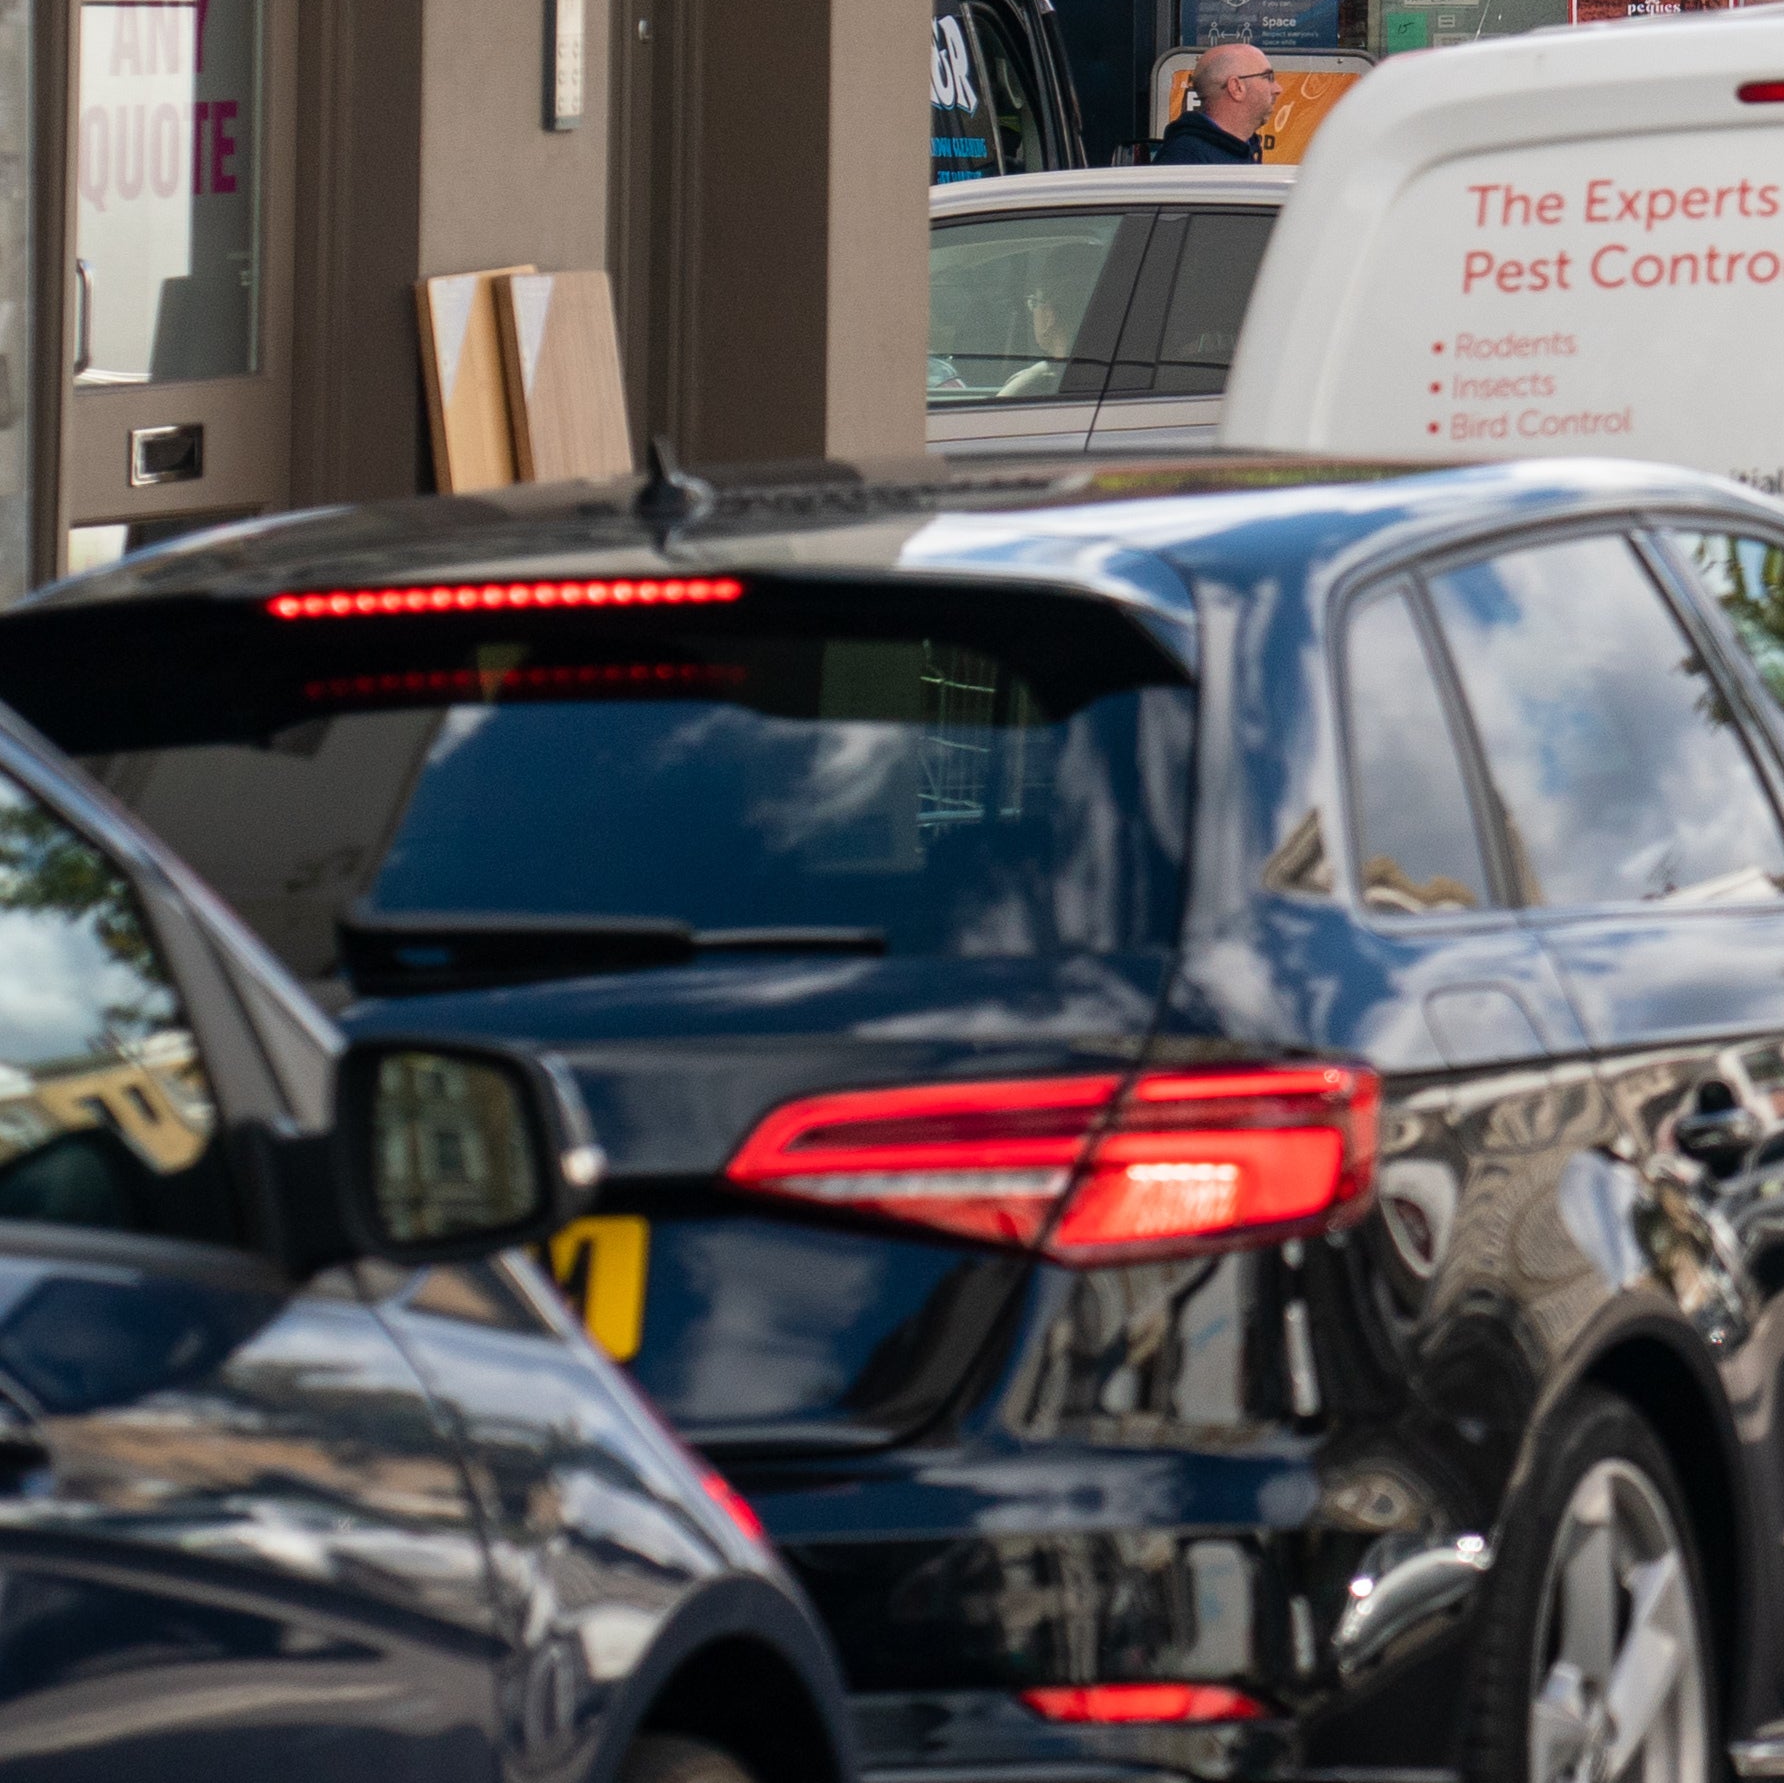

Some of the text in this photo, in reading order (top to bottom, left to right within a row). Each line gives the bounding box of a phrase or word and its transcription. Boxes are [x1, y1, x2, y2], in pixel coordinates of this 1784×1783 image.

[1262, 16, 1297, 29] Space
[76, 100, 238, 212] QUOTE
[1468, 182, 1565, 229] The
[1583, 176, 1781, 231] Experts
[1462, 248, 1573, 295] Pest
[1453, 330, 1577, 361] Rodents
[1451, 371, 1556, 400] Insects
[1449, 407, 1634, 442] Bird Control
